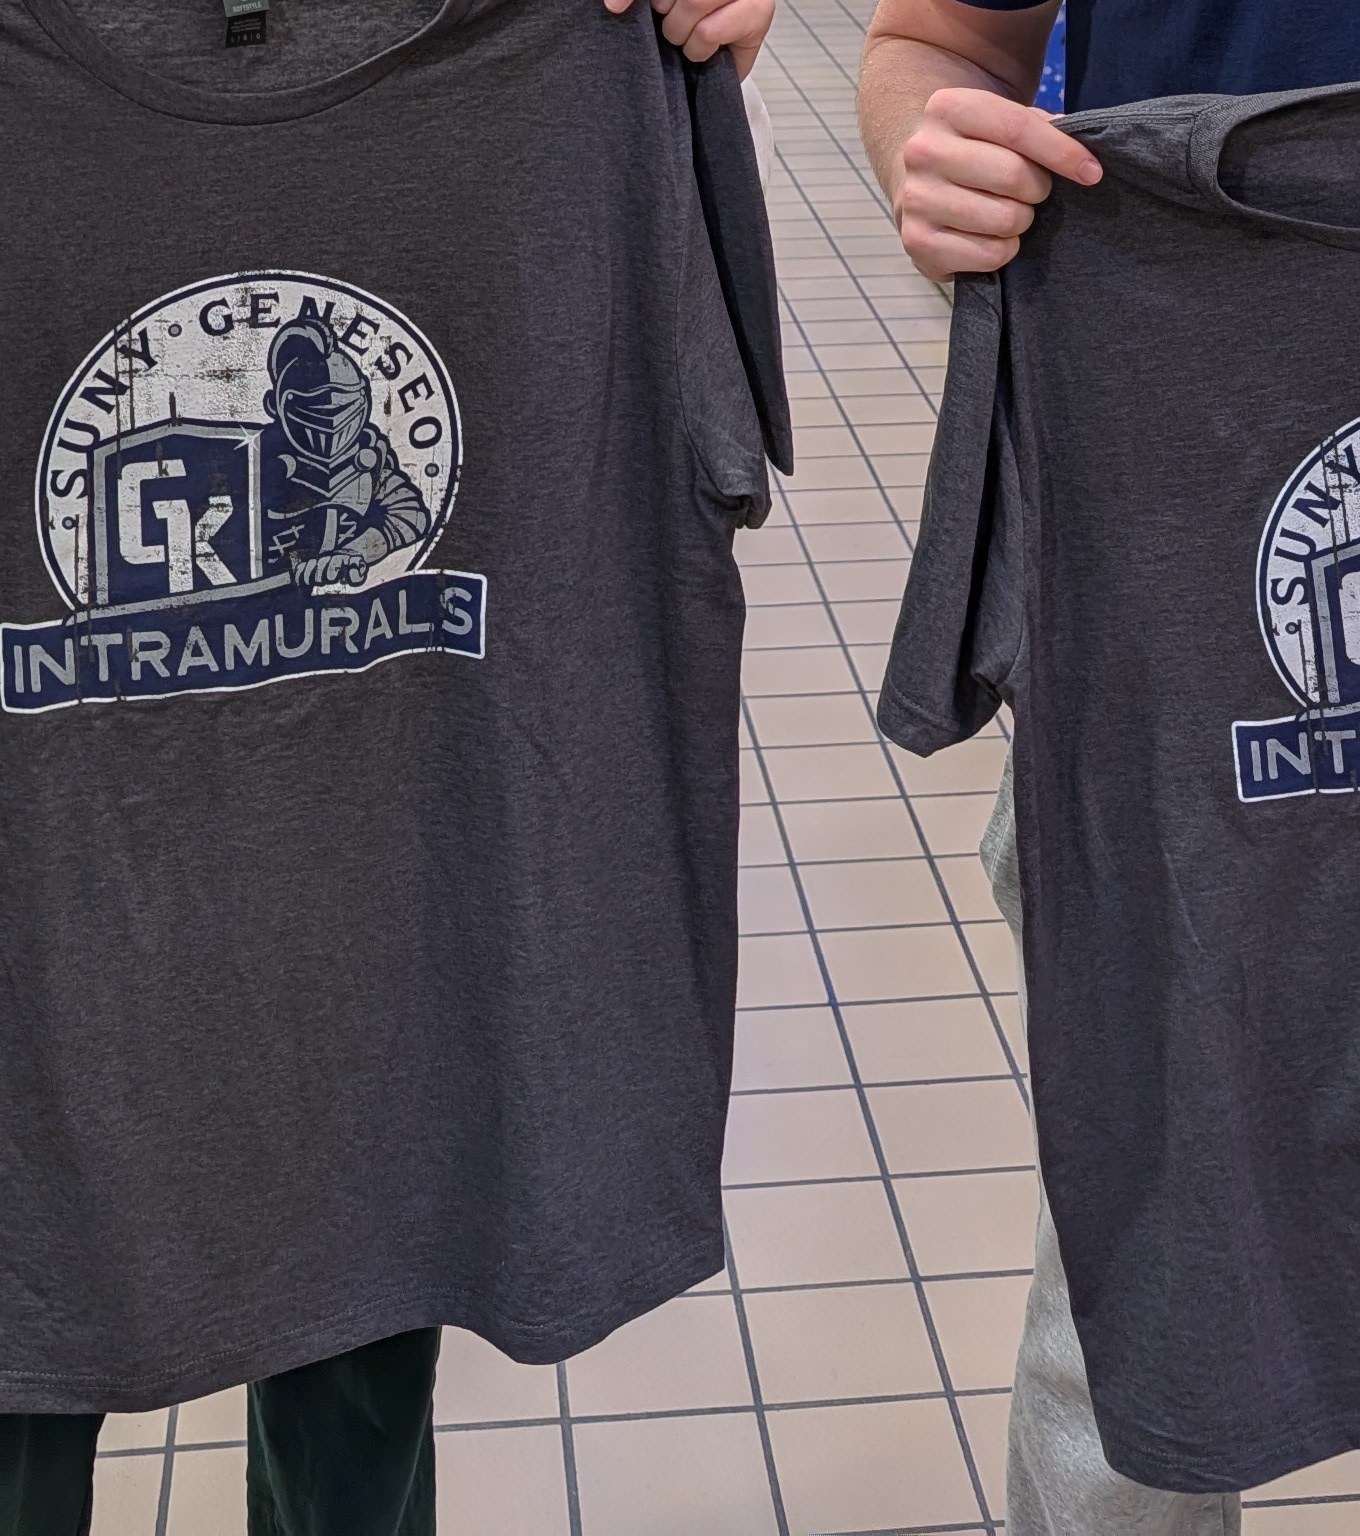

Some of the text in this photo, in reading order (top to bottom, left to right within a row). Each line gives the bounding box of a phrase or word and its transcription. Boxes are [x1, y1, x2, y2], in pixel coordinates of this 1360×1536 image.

[50, 292, 443, 500] SUNY GENESEO
[13, 586, 474, 694] INTRAMURALS
